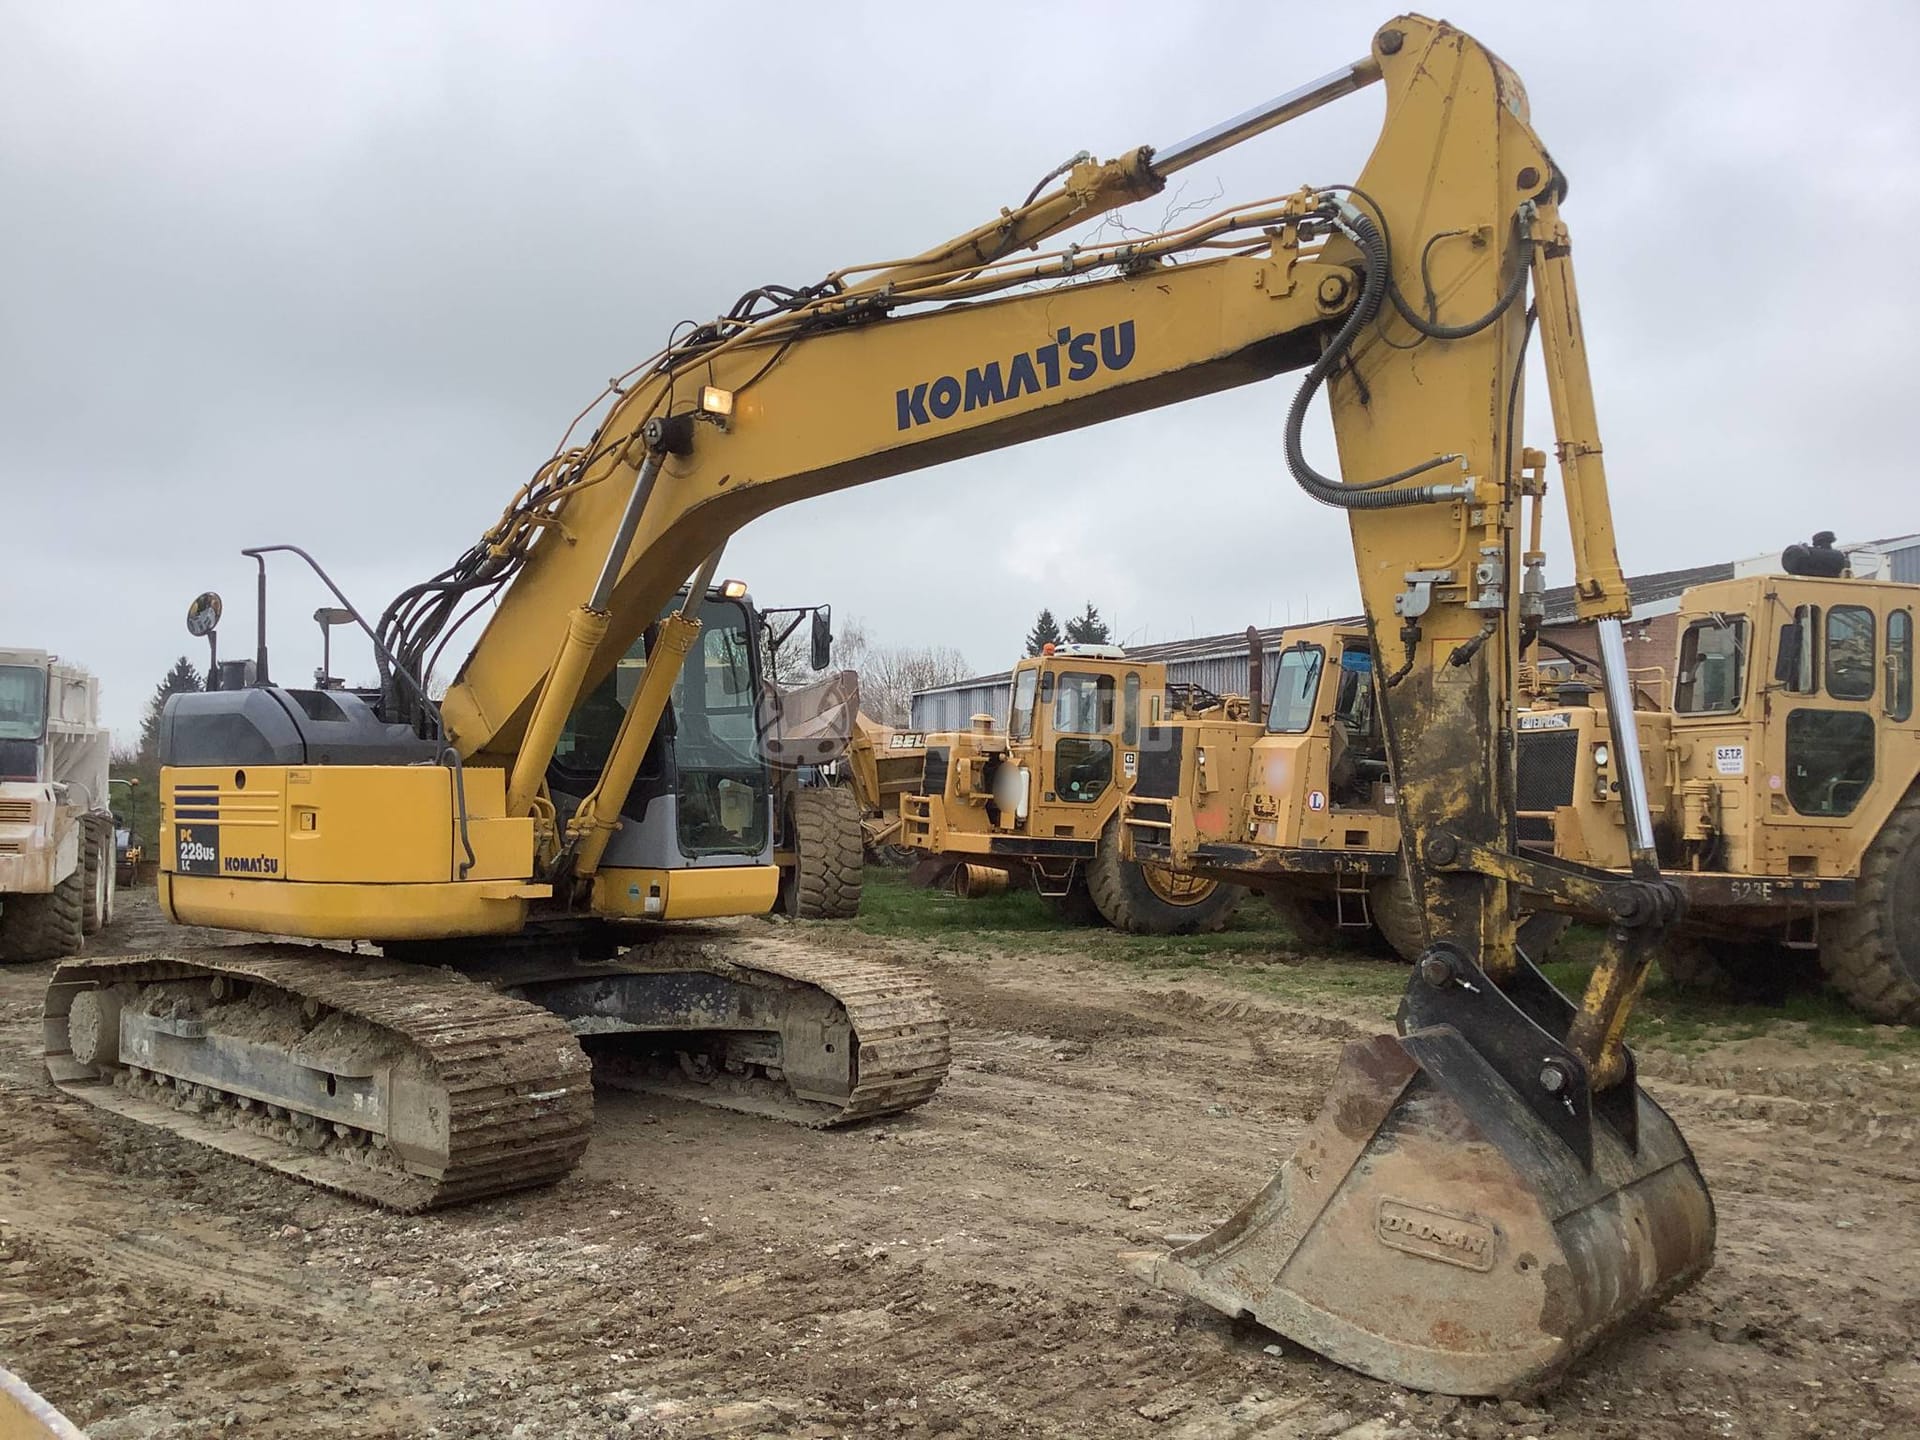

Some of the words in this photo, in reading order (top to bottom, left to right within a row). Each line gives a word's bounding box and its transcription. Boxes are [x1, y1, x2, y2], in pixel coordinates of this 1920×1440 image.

[896, 320, 1136, 431] KOMATSU
[180, 829, 192, 842] PC
[180, 842, 215, 861] 228US
[181, 860, 190, 871] LC
[224, 854, 278, 874] KOMATSU
